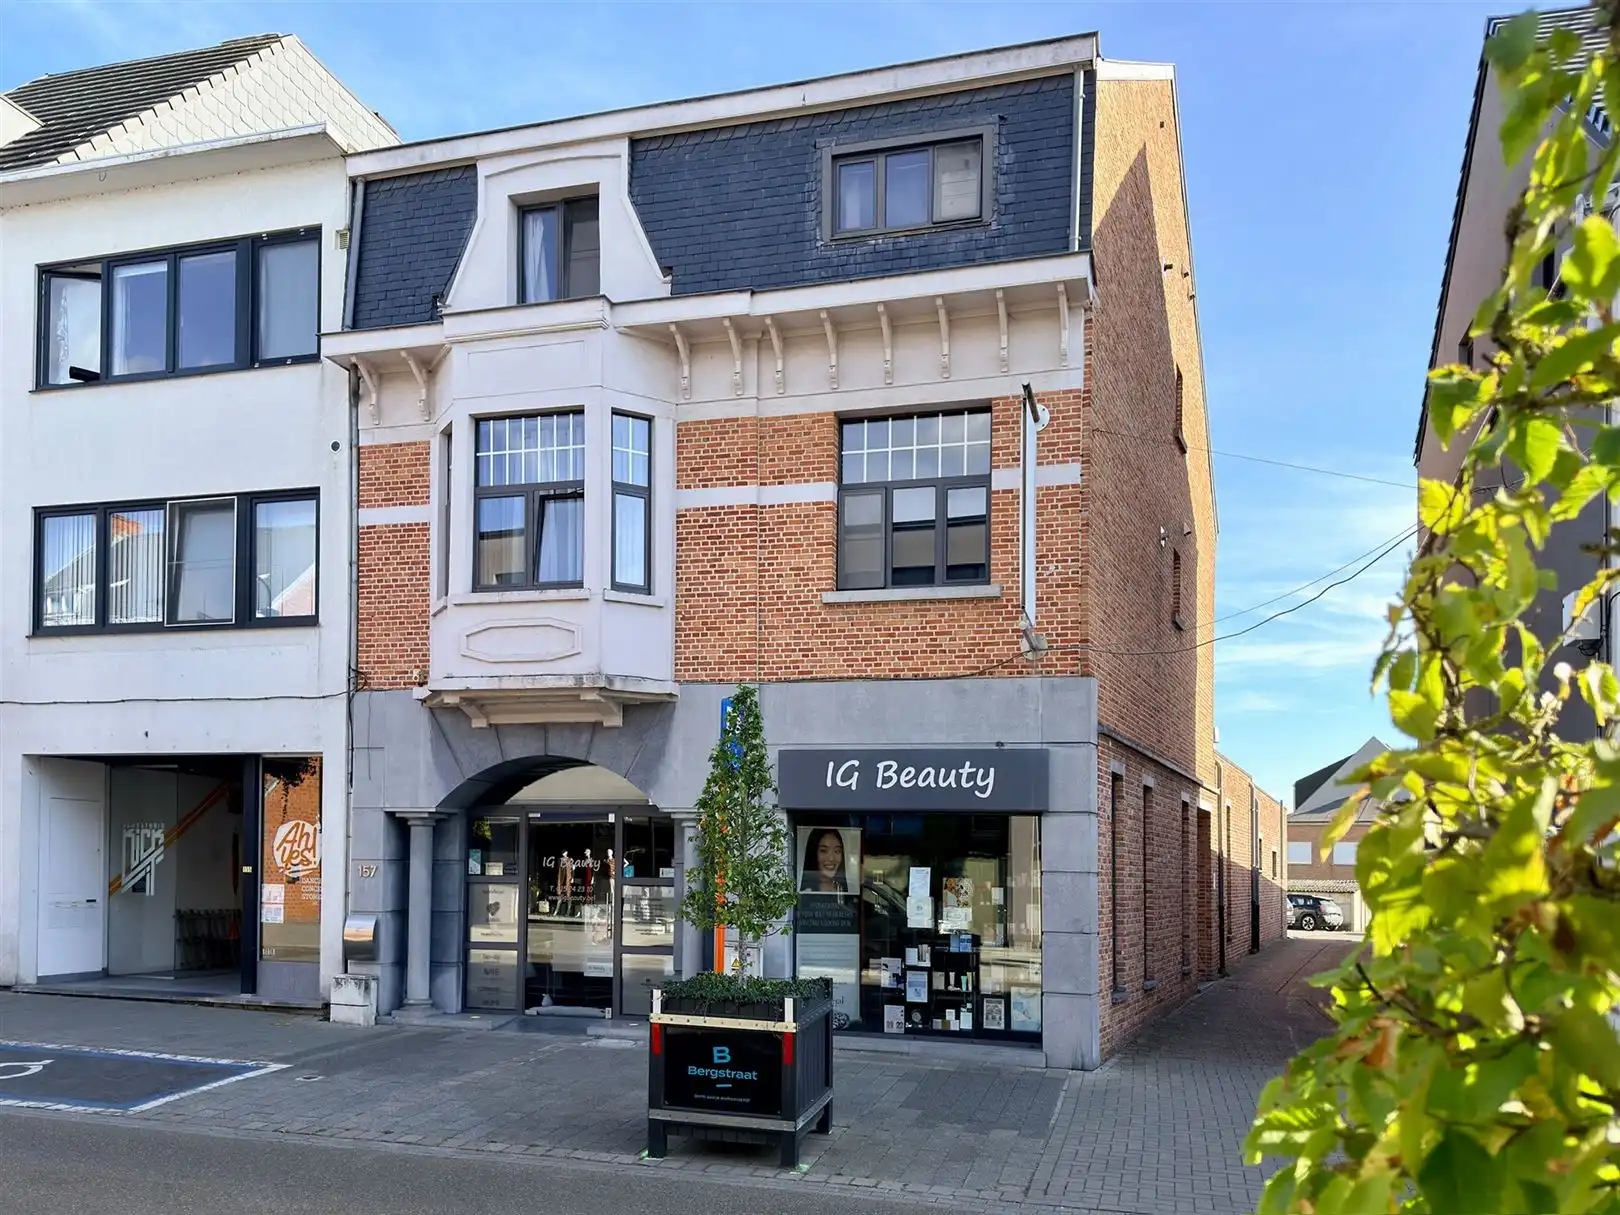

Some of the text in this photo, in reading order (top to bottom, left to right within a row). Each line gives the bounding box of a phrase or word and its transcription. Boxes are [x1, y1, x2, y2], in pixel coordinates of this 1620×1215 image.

[826, 759, 996, 798] IG Beauty
[358, 864, 378, 878] 157
[542, 856, 601, 872] IG Beauty
[712, 1046, 731, 1064] B
[687, 1065, 758, 1081] Bergstraat
